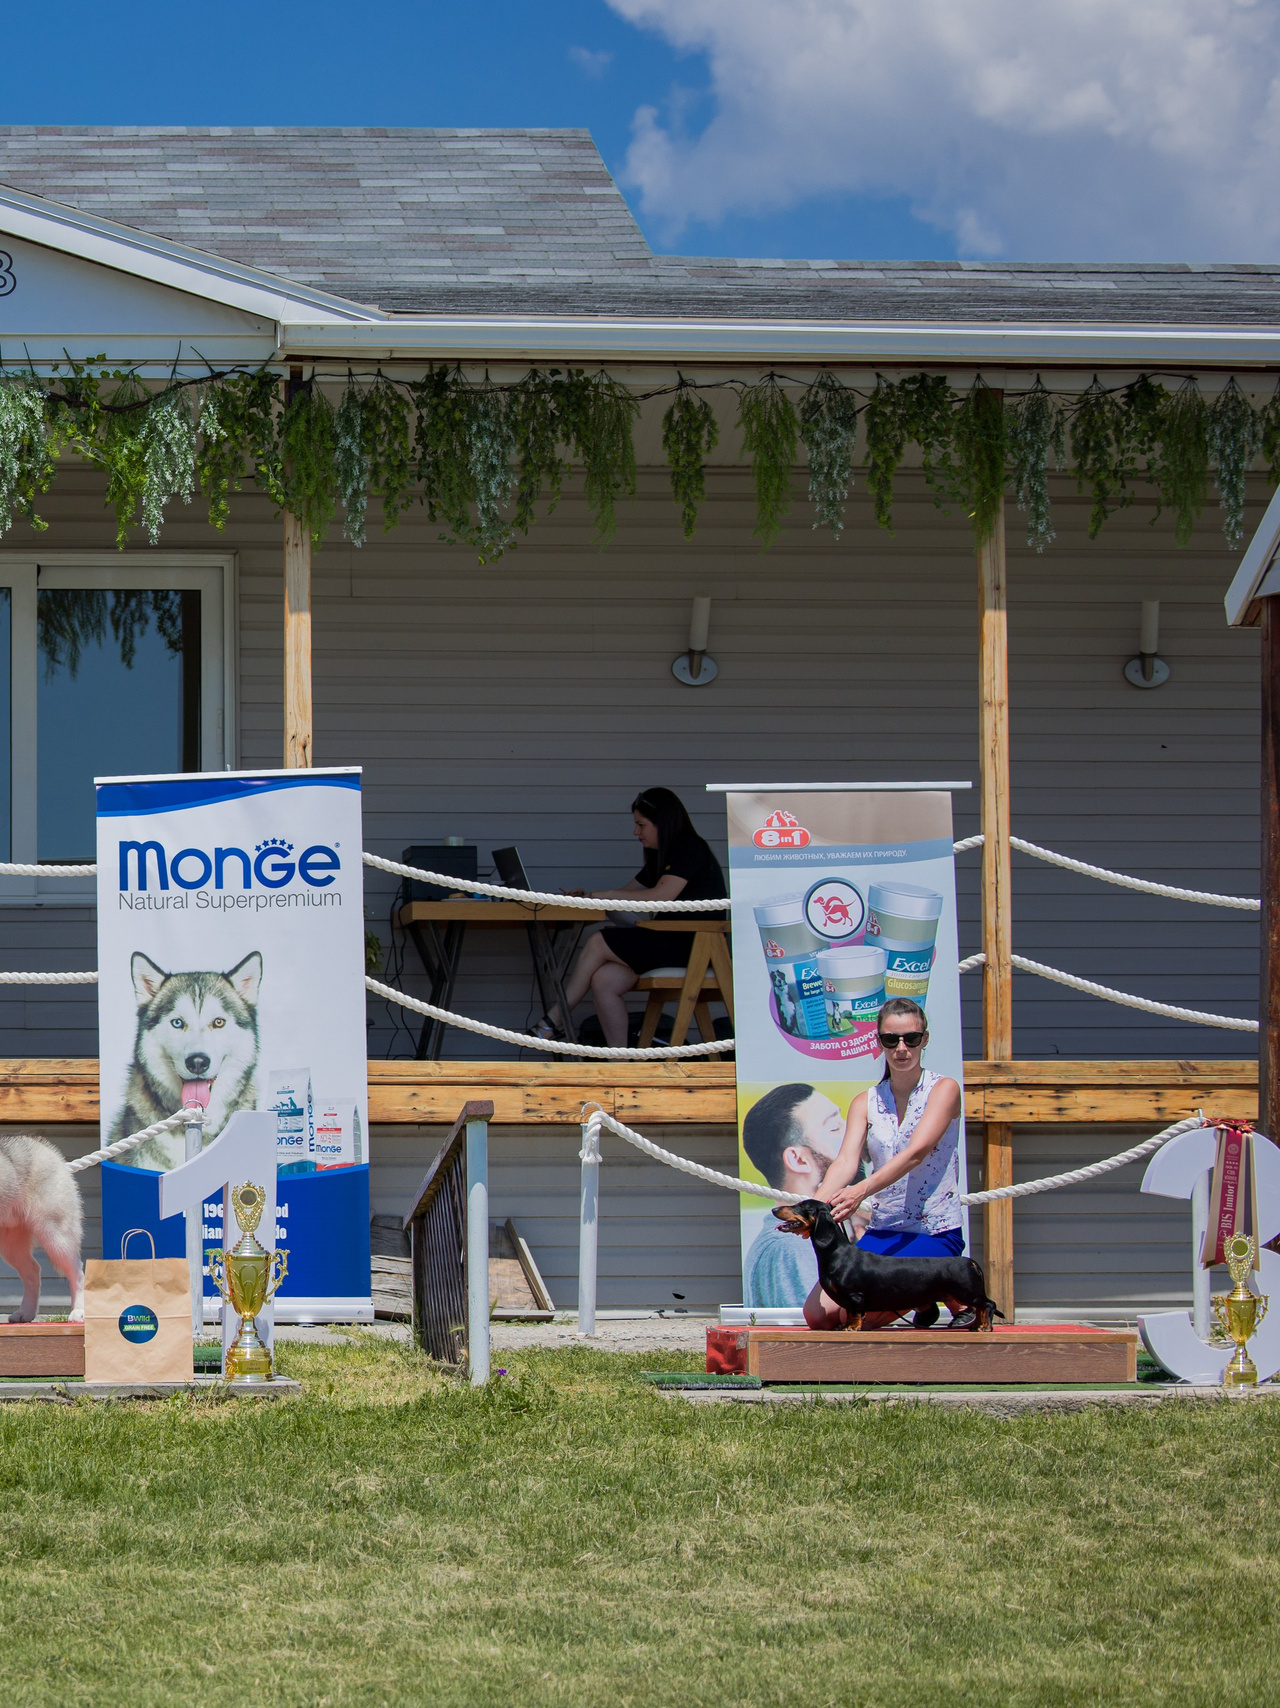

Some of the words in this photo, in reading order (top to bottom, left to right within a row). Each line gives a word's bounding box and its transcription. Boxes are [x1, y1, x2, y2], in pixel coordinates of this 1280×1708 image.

[753, 854, 782, 862] ЛЮБИМ
[783, 853, 826, 861] ЖИВОТНЫХ,
[826, 851, 862, 860] УВАЖАЕМ
[118, 891, 189, 910] Natural
[195, 889, 342, 912] Superpremium
[892, 957, 931, 972] Excel
[802, 980, 823, 990] Brewe
[854, 998, 879, 1010] Excel
[810, 1041, 841, 1050] ЗАБОТА
[848, 1029, 878, 1047] ЗДОРО
[1222, 1184, 1236, 1212] Junior
[1220, 1213, 1234, 1229] BIS
[159, 1111, 278, 1379] 1
